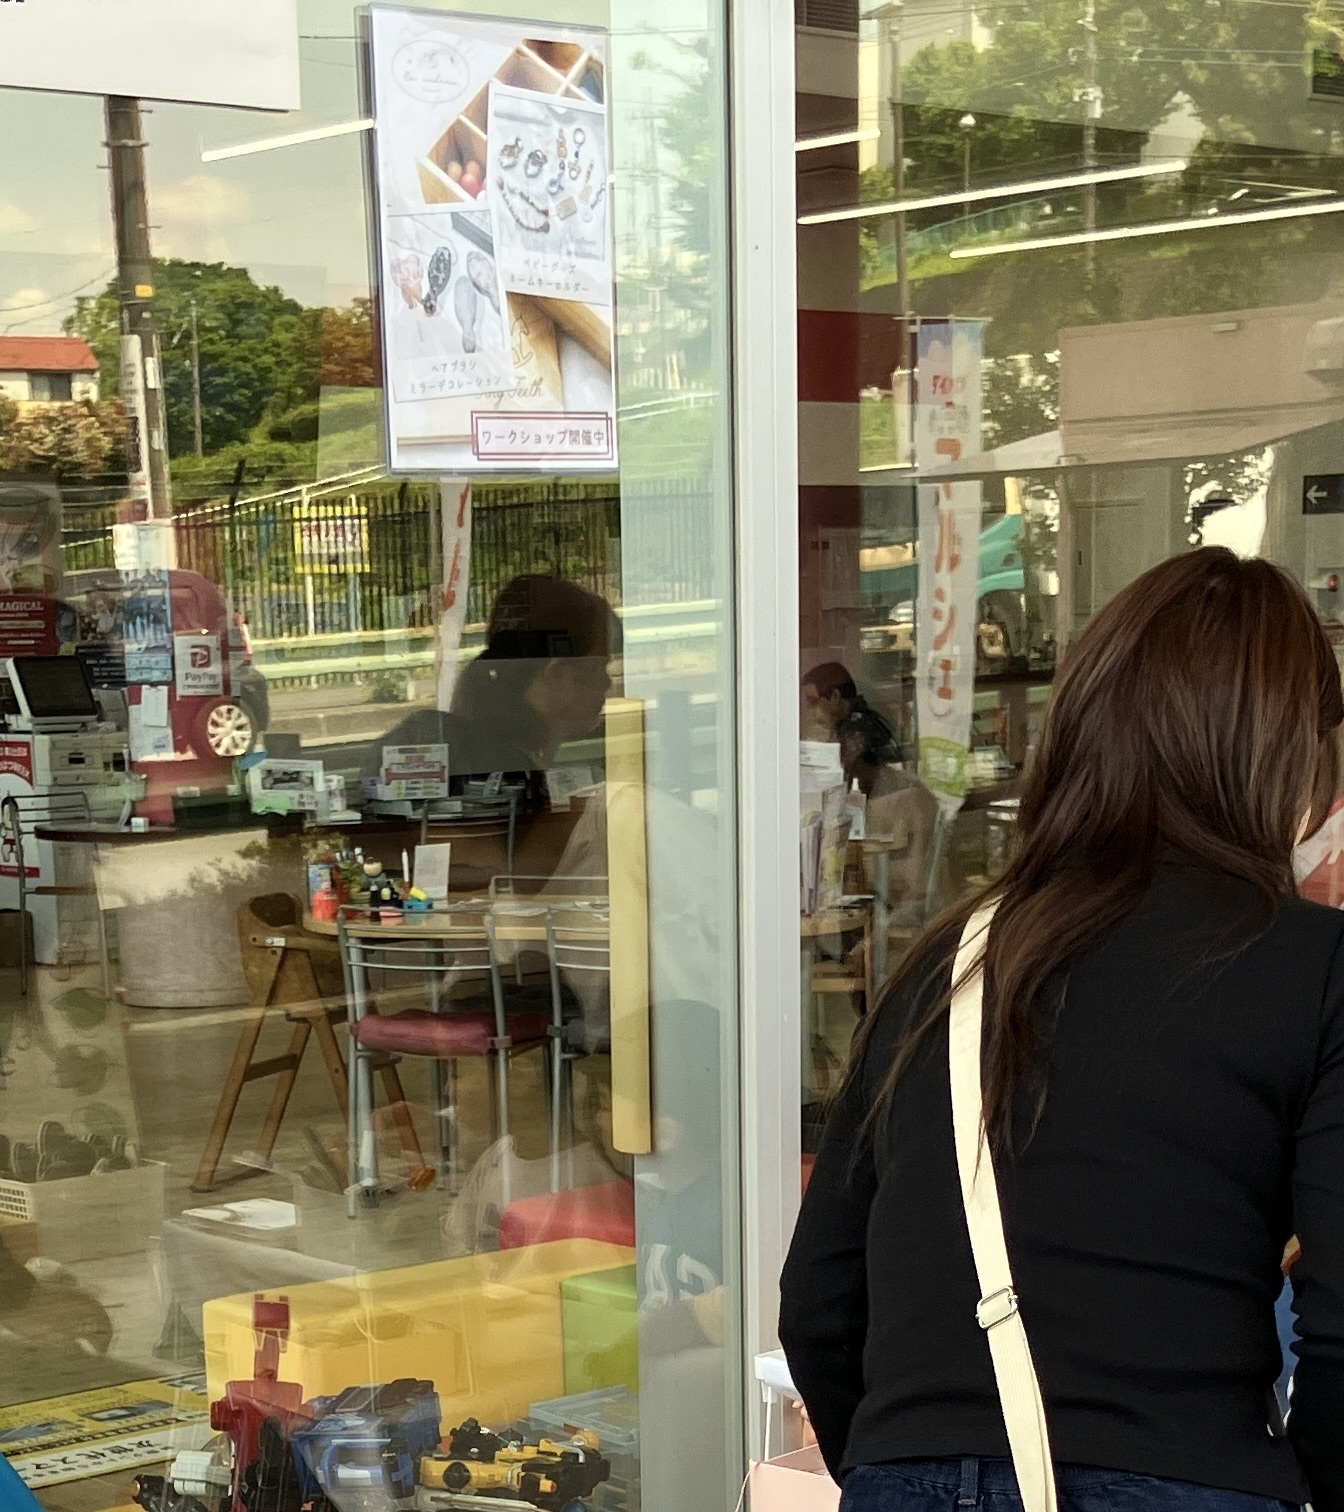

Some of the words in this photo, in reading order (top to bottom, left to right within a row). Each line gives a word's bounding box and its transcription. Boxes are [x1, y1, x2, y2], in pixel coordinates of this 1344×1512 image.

[481, 428, 606, 447] ワークショップ開催中
